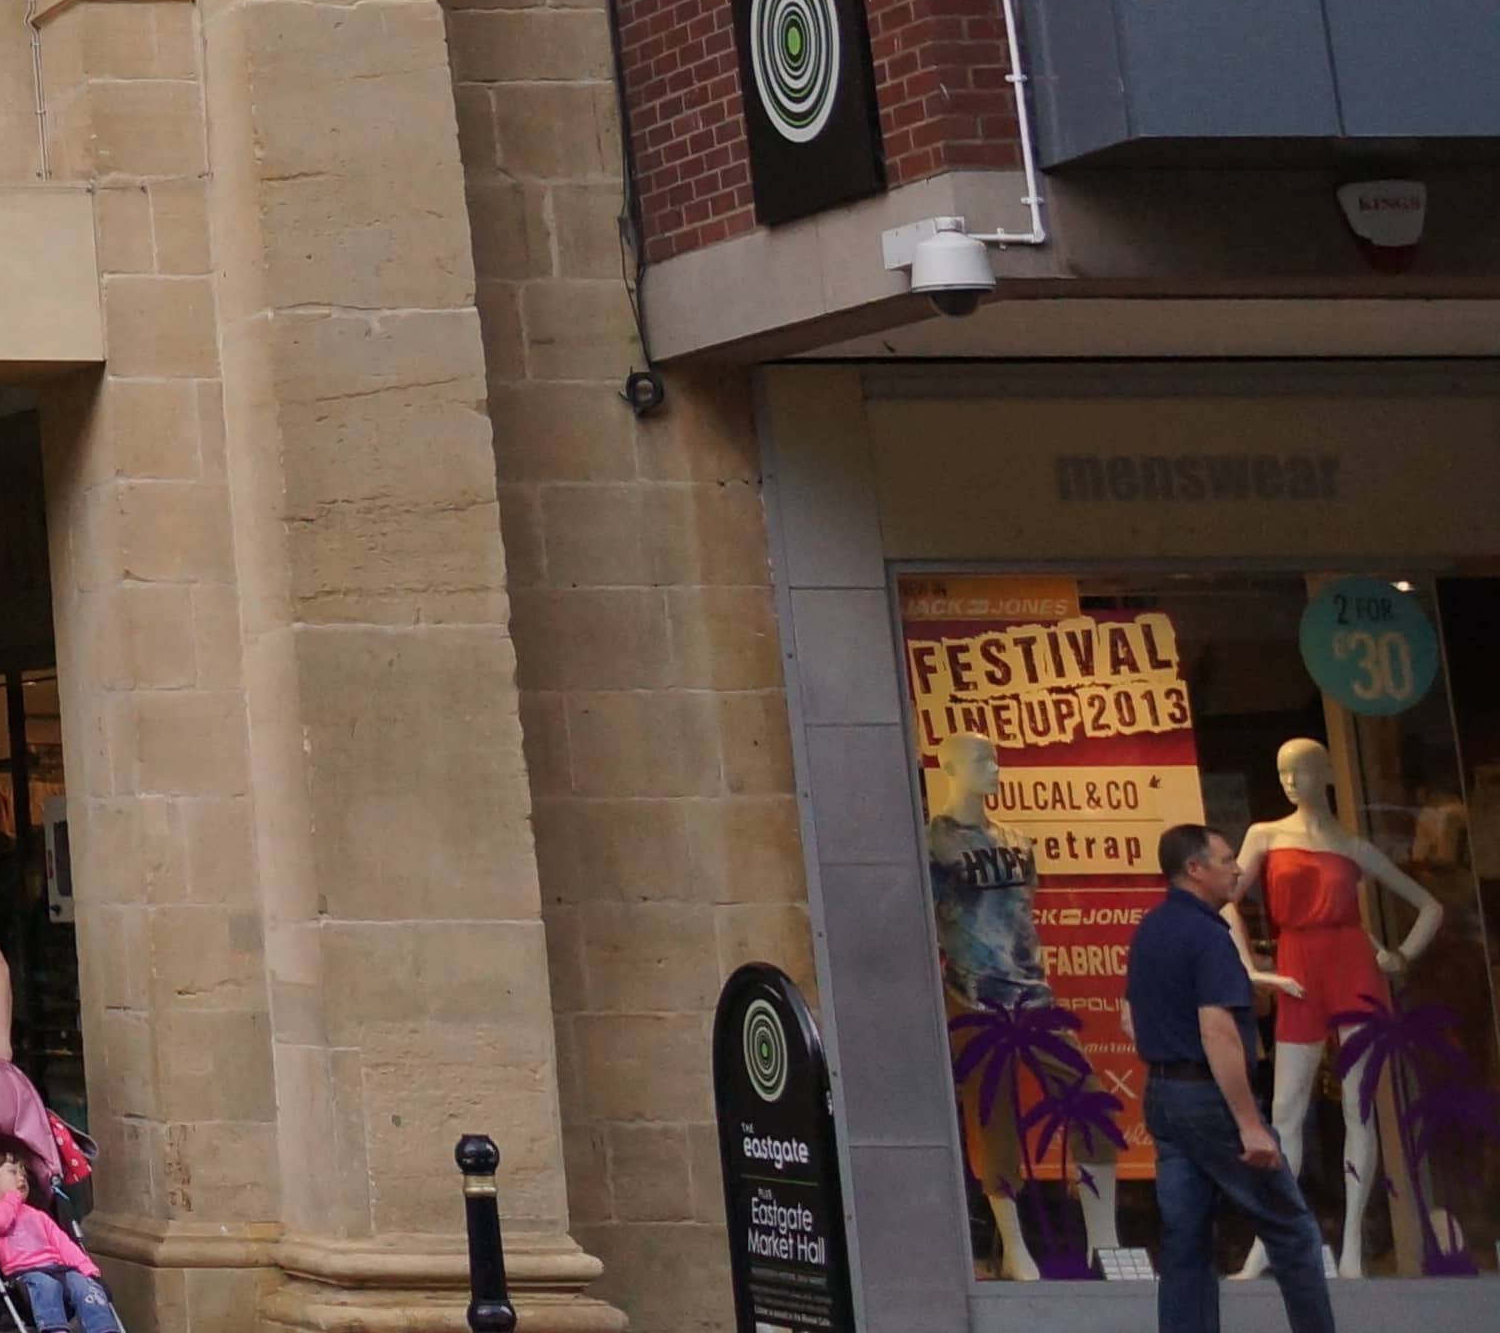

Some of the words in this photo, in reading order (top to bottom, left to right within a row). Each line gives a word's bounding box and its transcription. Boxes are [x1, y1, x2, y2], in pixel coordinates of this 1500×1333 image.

[1056, 452, 1339, 501] menswear
[1334, 595, 1349, 624] 2
[1356, 595, 1394, 621] FOR
[912, 623, 1174, 694] FESTIVAL
[1332, 630, 1414, 700] £30
[1025, 698, 1077, 737] UP
[1087, 687, 1189, 732] 2013
[741, 1122, 754, 1133] THE
[743, 1136, 809, 1170] eastgate
[751, 1197, 813, 1234] Eastgate
[748, 1227, 794, 1260] Market
[797, 1236, 825, 1265] Hall
